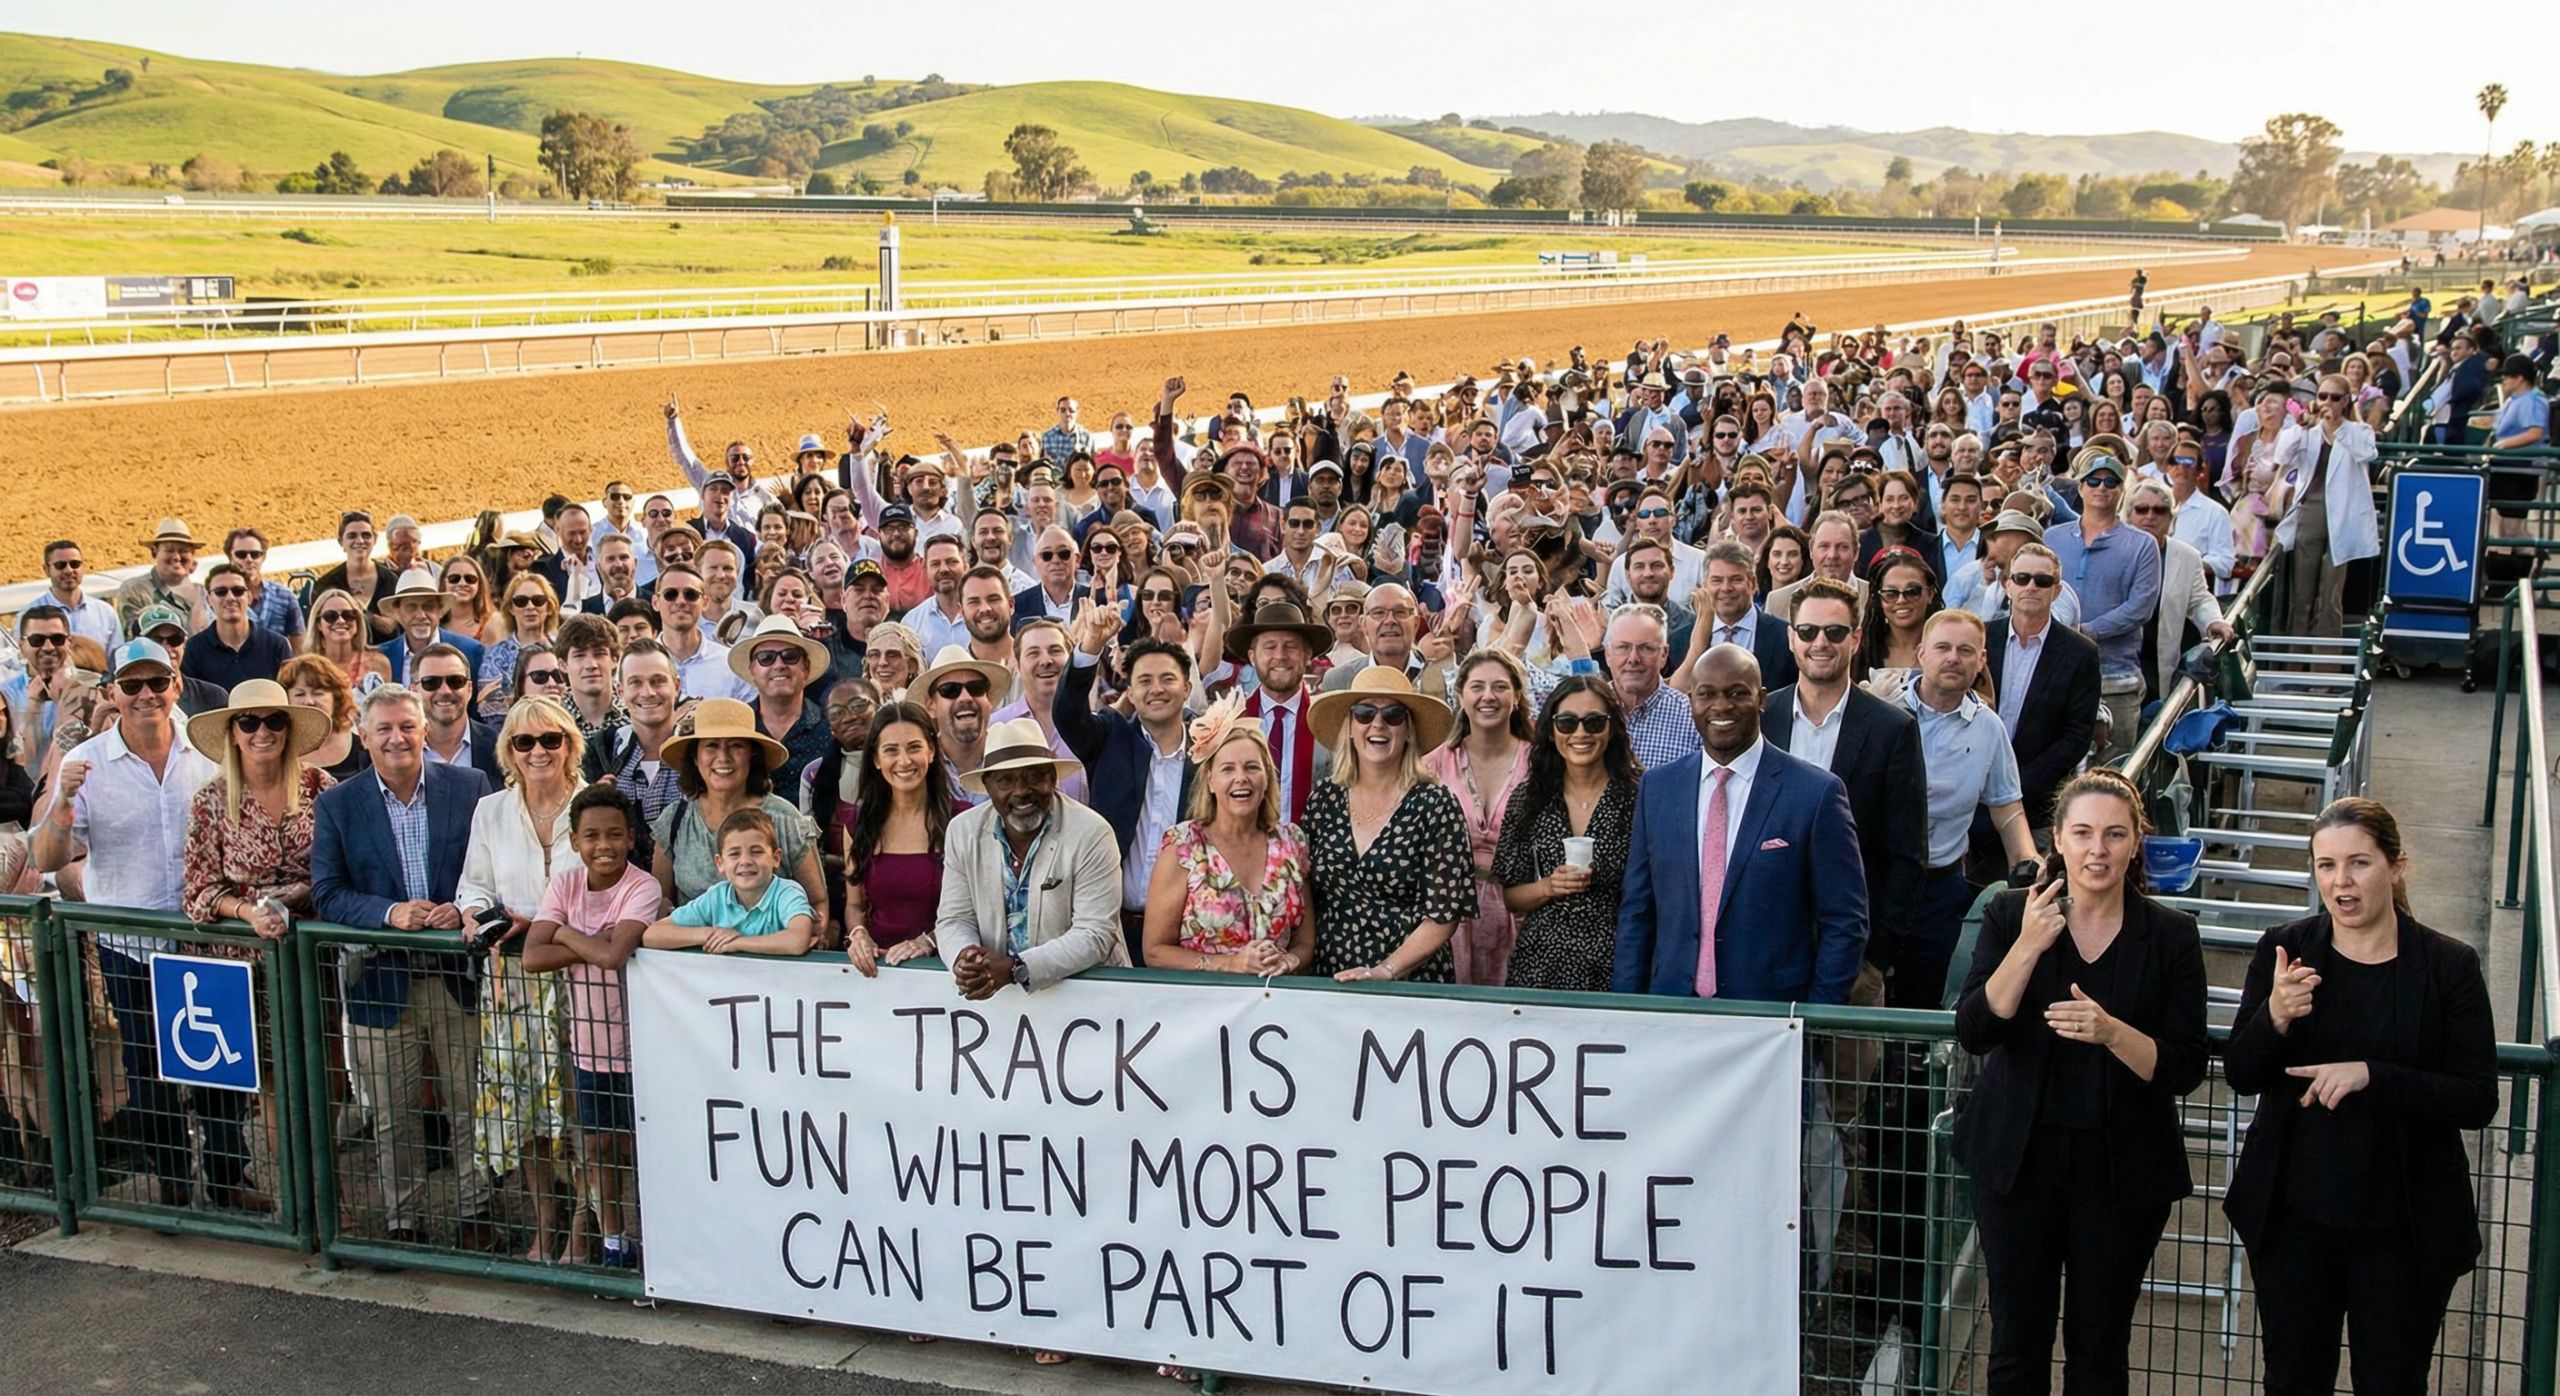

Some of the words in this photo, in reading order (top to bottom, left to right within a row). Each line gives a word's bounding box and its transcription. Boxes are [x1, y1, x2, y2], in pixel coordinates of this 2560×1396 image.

[707, 994, 853, 1080] THE
[891, 1006, 1170, 1114] TRACK
[1218, 1023, 1298, 1119] IS
[1351, 1030, 1628, 1142] MORE
[705, 1097, 850, 1196] FUN
[883, 1120, 1088, 1219] WHEN
[1127, 1136, 1342, 1241] MORE
[1381, 1150, 1697, 1273] PEOPLE
[780, 1210, 925, 1303] CAN
[964, 1231, 1059, 1319] BE
[1099, 1241, 1309, 1348] PART
[1339, 1269, 1446, 1361] OF
[1495, 1282, 1585, 1377] IT
